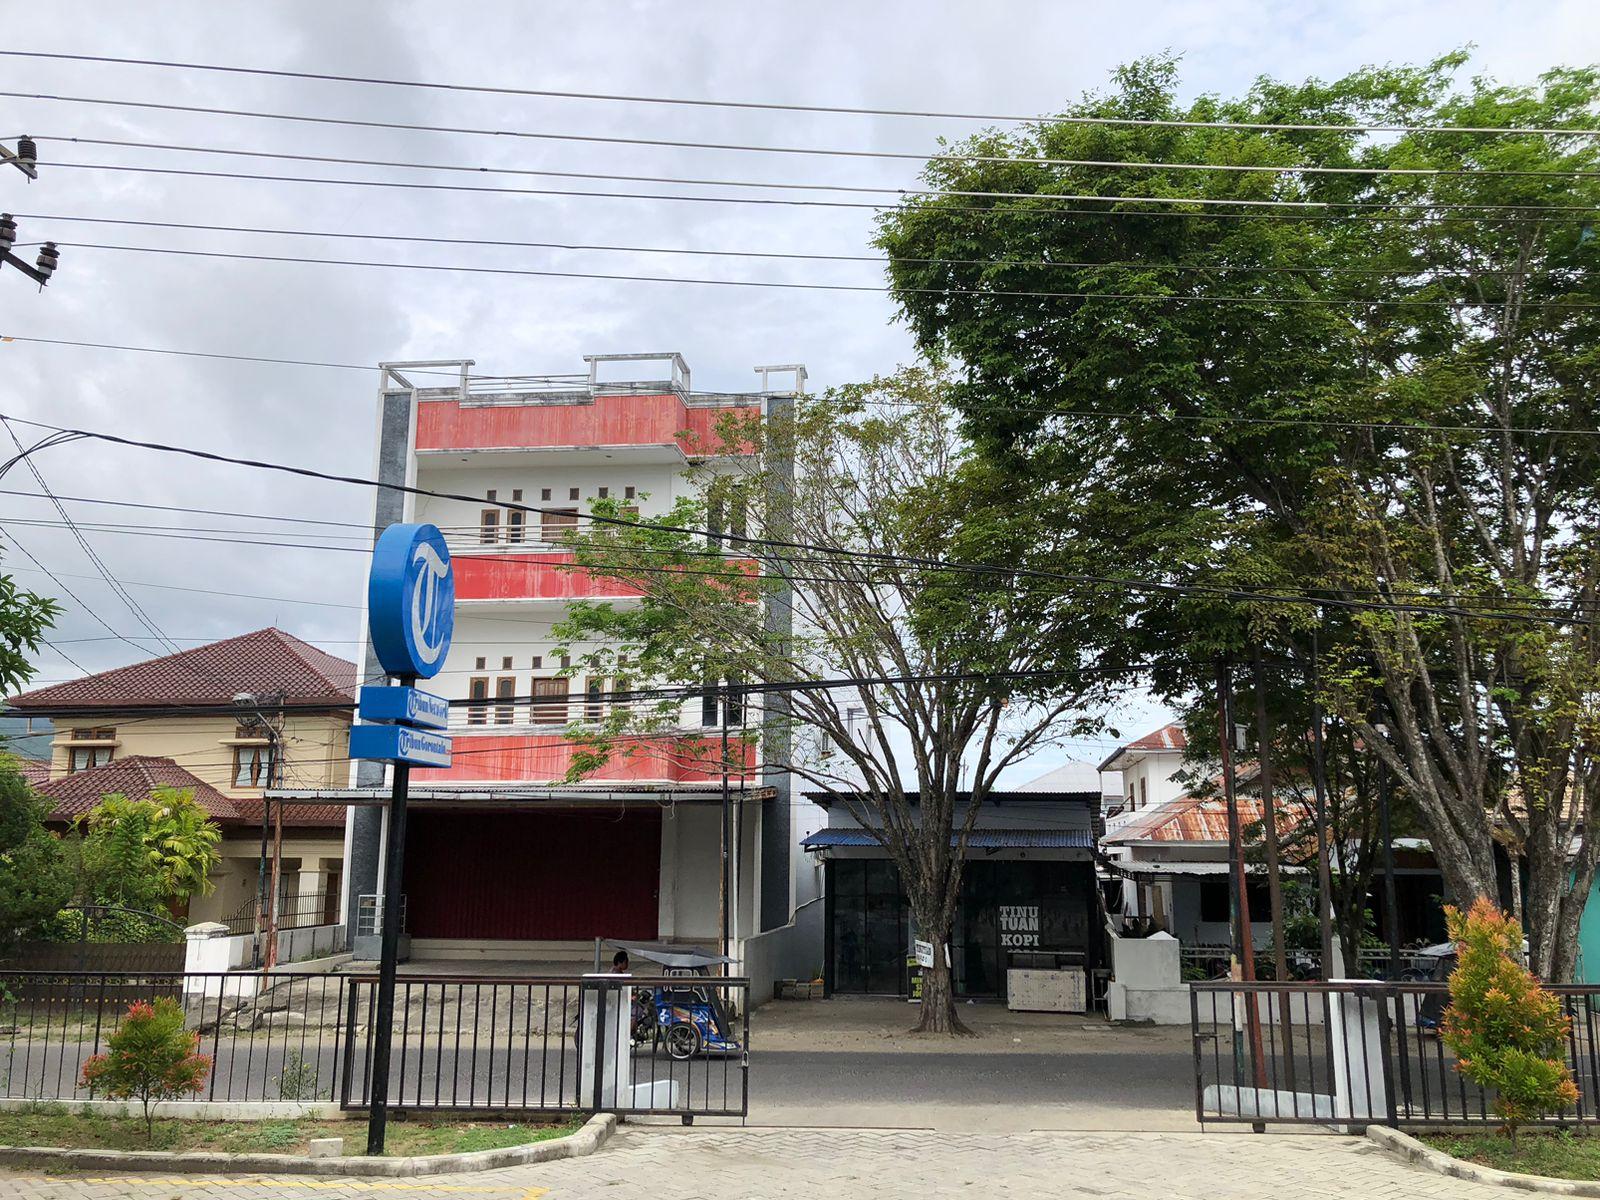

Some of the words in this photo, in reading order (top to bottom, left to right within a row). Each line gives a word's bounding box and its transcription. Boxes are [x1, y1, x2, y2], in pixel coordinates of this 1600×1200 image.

[999, 905, 1039, 918] TINU
[999, 917, 1039, 931] TUAN
[1000, 933, 1040, 947] KOPI
